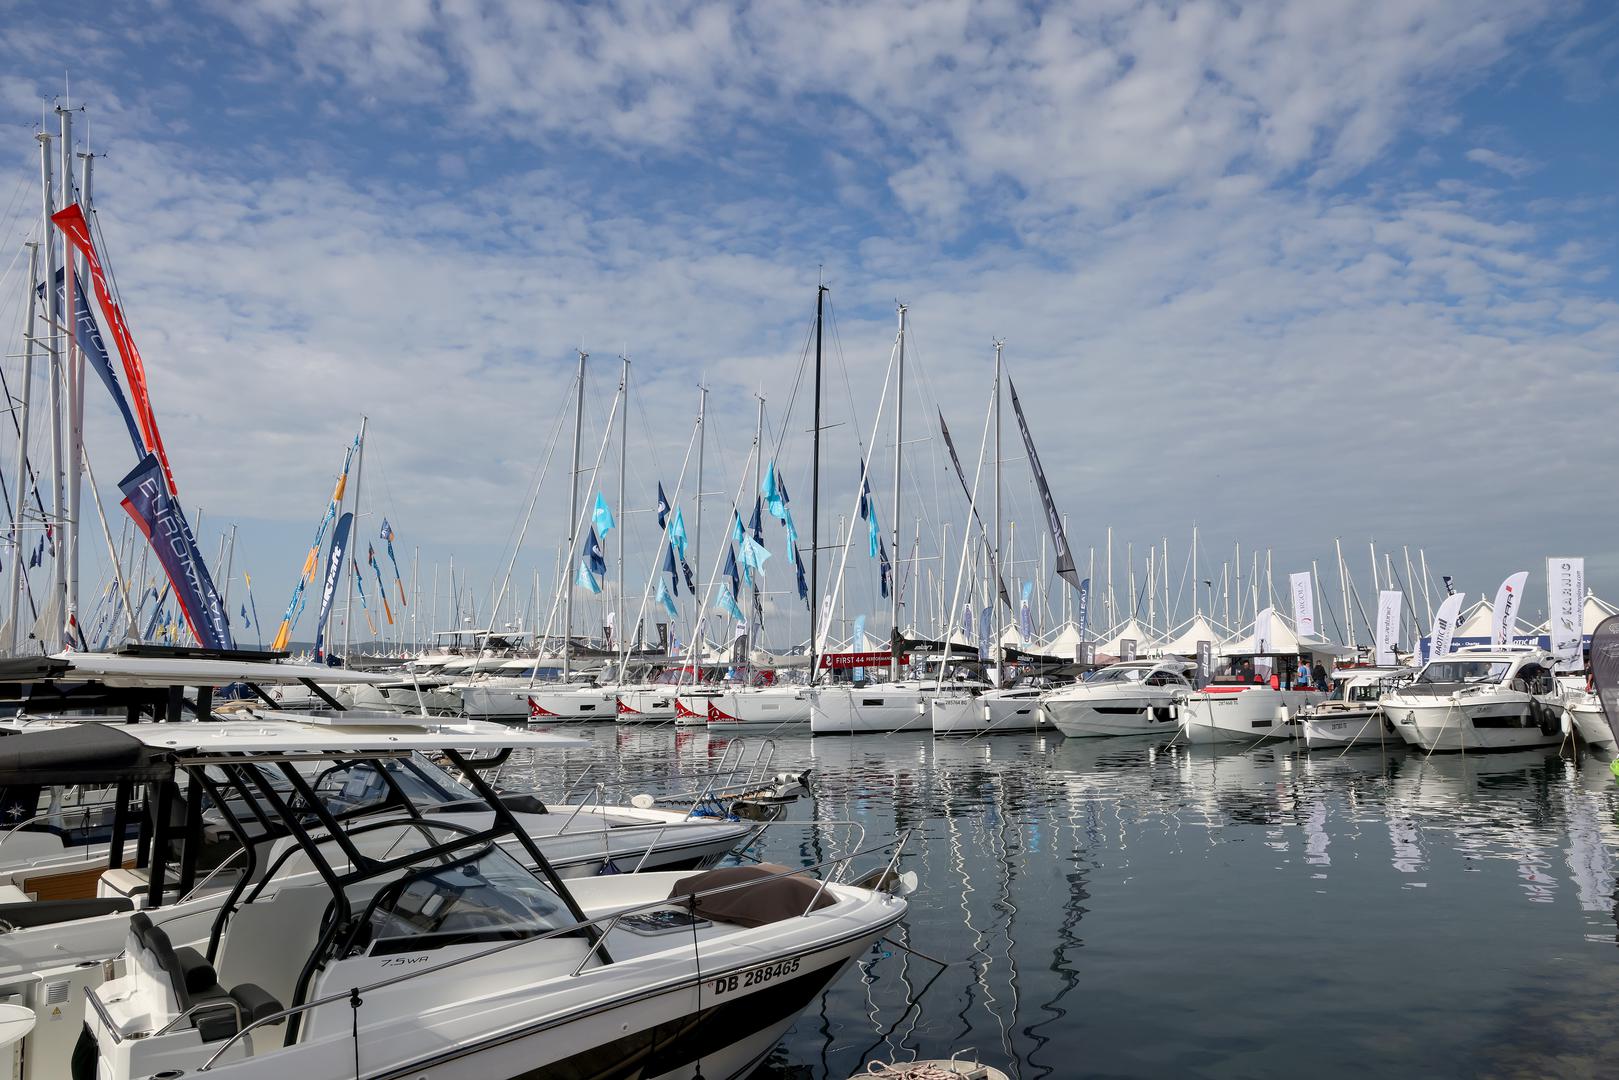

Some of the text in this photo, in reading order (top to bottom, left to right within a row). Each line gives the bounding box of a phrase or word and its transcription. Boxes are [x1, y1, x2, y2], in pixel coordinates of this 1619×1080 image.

[1561, 563, 1573, 615] KARNIC
[835, 656, 854, 665] FIRST
[856, 656, 865, 664] 44
[714, 958, 801, 995] DB 288465
